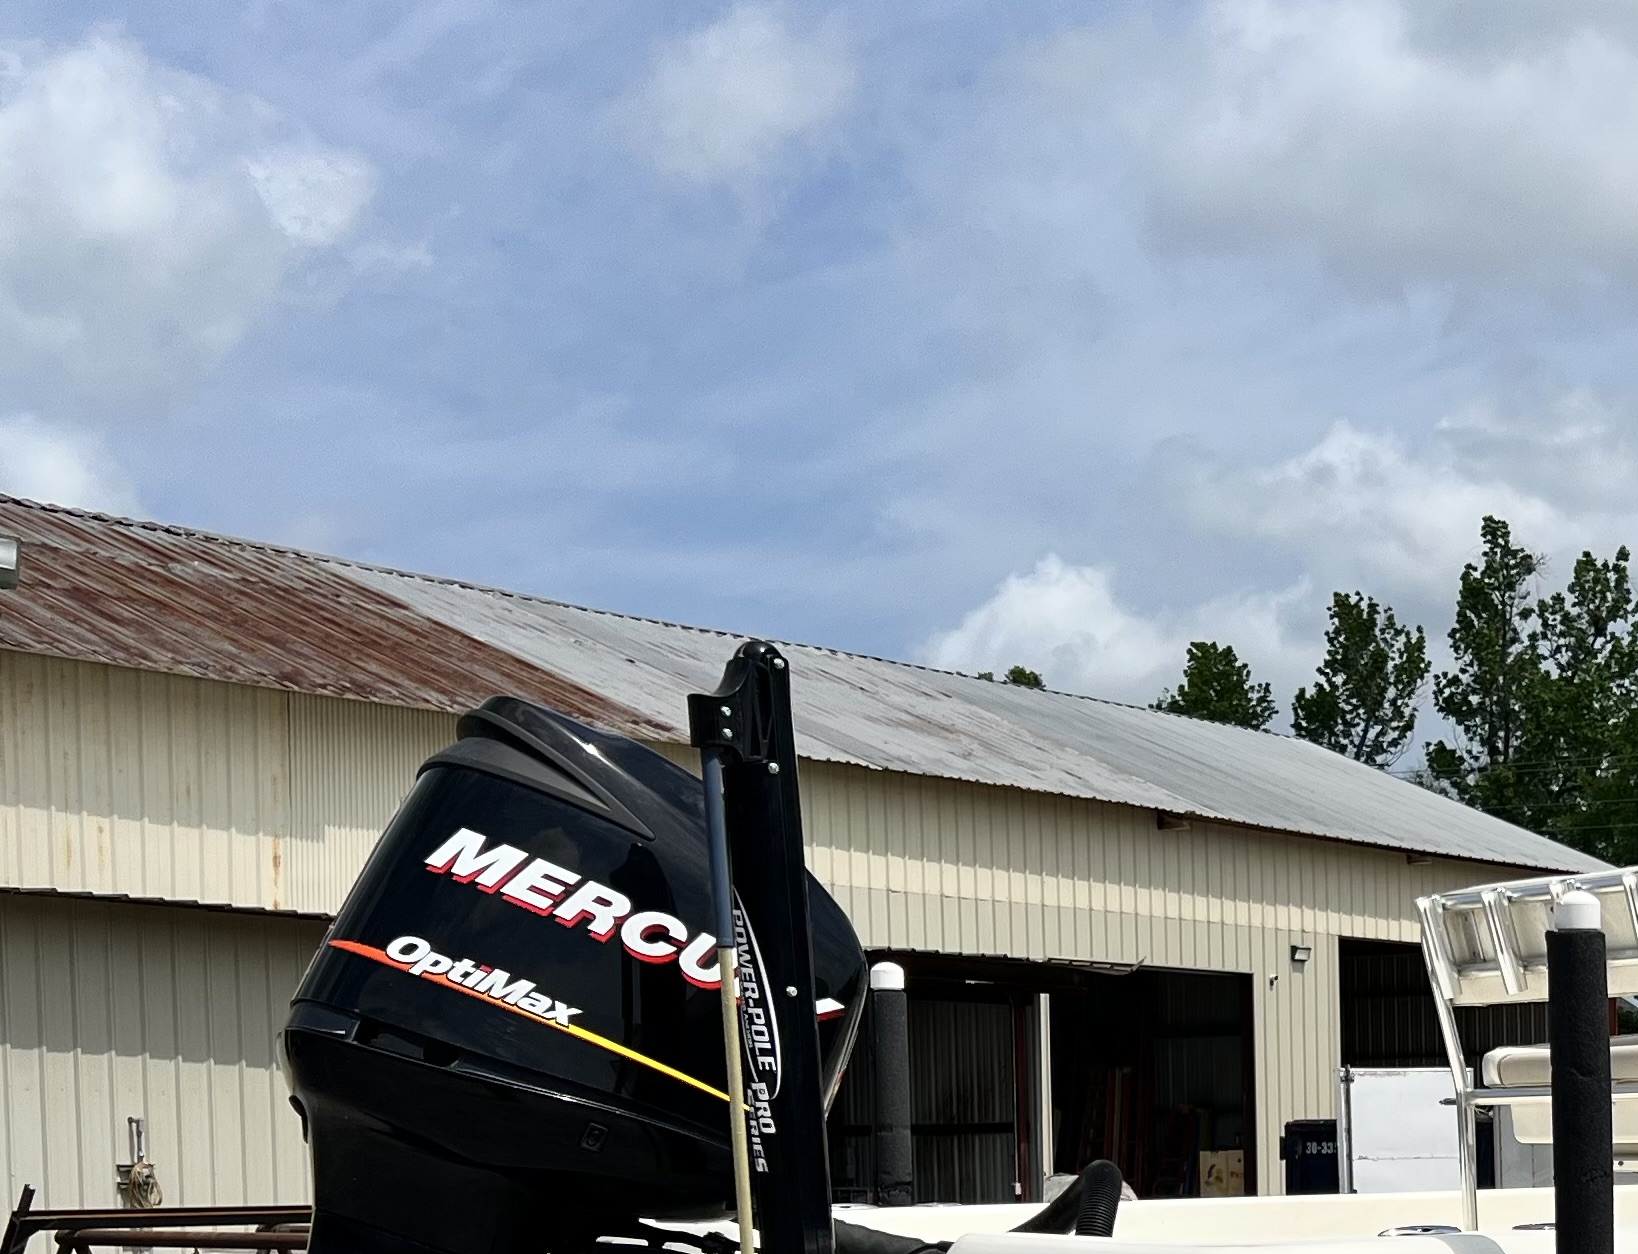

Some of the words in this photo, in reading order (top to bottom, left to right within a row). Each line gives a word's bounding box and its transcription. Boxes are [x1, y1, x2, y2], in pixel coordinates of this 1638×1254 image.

[424, 827, 742, 993] MERCU
[386, 936, 583, 1027] OptiMax
[733, 909, 777, 1073] POWER-POLE
[751, 1082, 777, 1134] PRO
